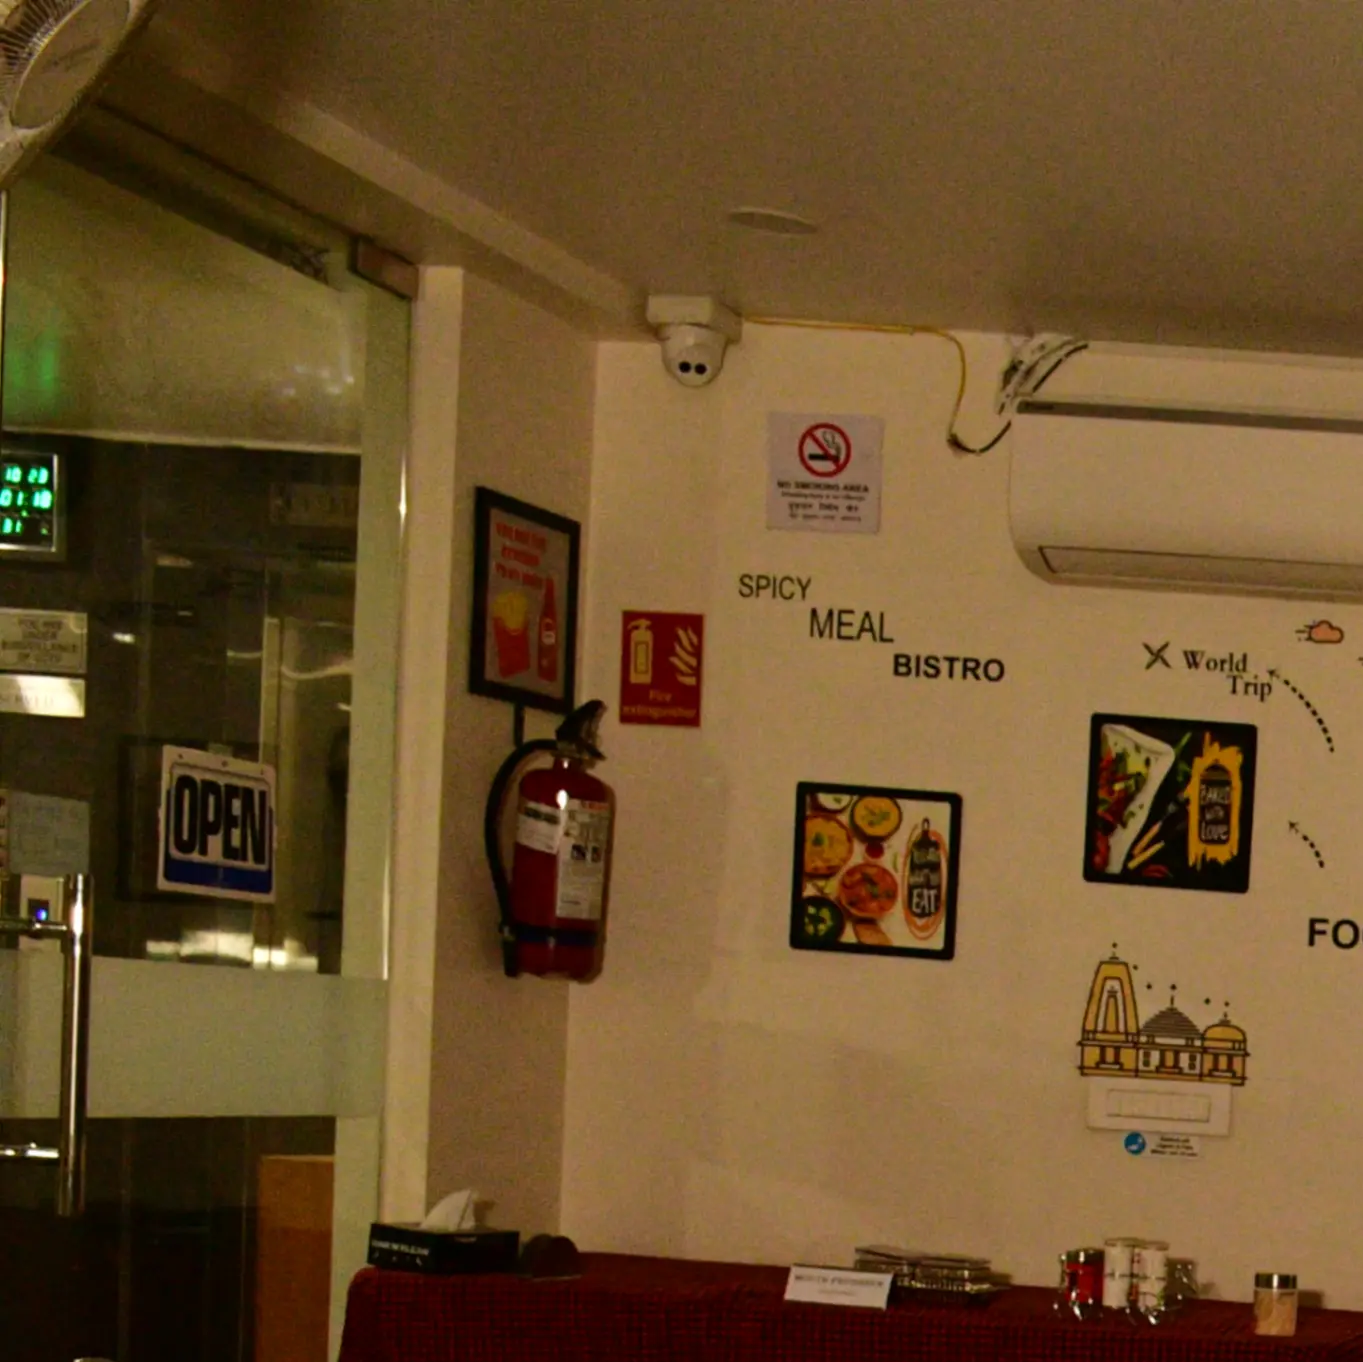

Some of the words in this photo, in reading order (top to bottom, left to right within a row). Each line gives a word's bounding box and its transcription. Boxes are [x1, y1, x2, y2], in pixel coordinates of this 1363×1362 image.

[738, 573, 812, 601] SPICY
[809, 607, 895, 643] MEAL
[893, 653, 1005, 682] BISTRO
[1182, 649, 1248, 672] World
[1227, 674, 1272, 702] Trip
[173, 774, 267, 866] OPEN
[912, 888, 938, 913] EAT
